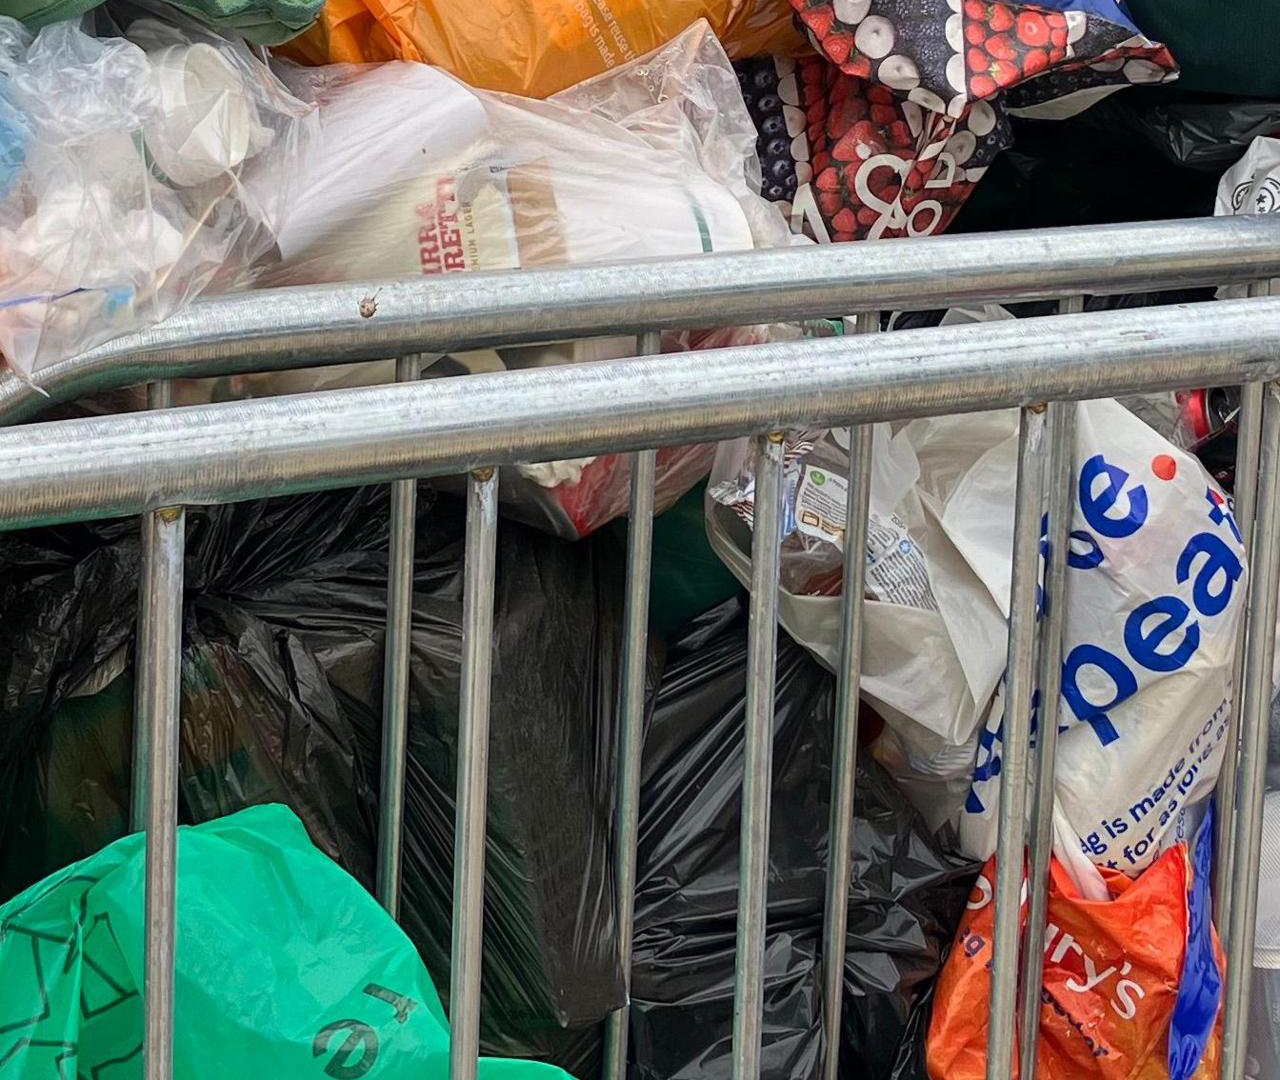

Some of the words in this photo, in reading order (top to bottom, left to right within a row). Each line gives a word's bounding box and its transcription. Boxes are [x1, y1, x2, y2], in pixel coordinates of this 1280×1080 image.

[575, 2, 594, 27] bag
[588, 24, 600, 37] is
[594, 34, 616, 68] made
[608, 20, 629, 53] reuse
[462, 201, 475, 234] LAGER
[1101, 818, 1128, 840] is
[1129, 757, 1185, 823] made
[1123, 826, 1156, 865] for
[1158, 799, 1178, 827] as
